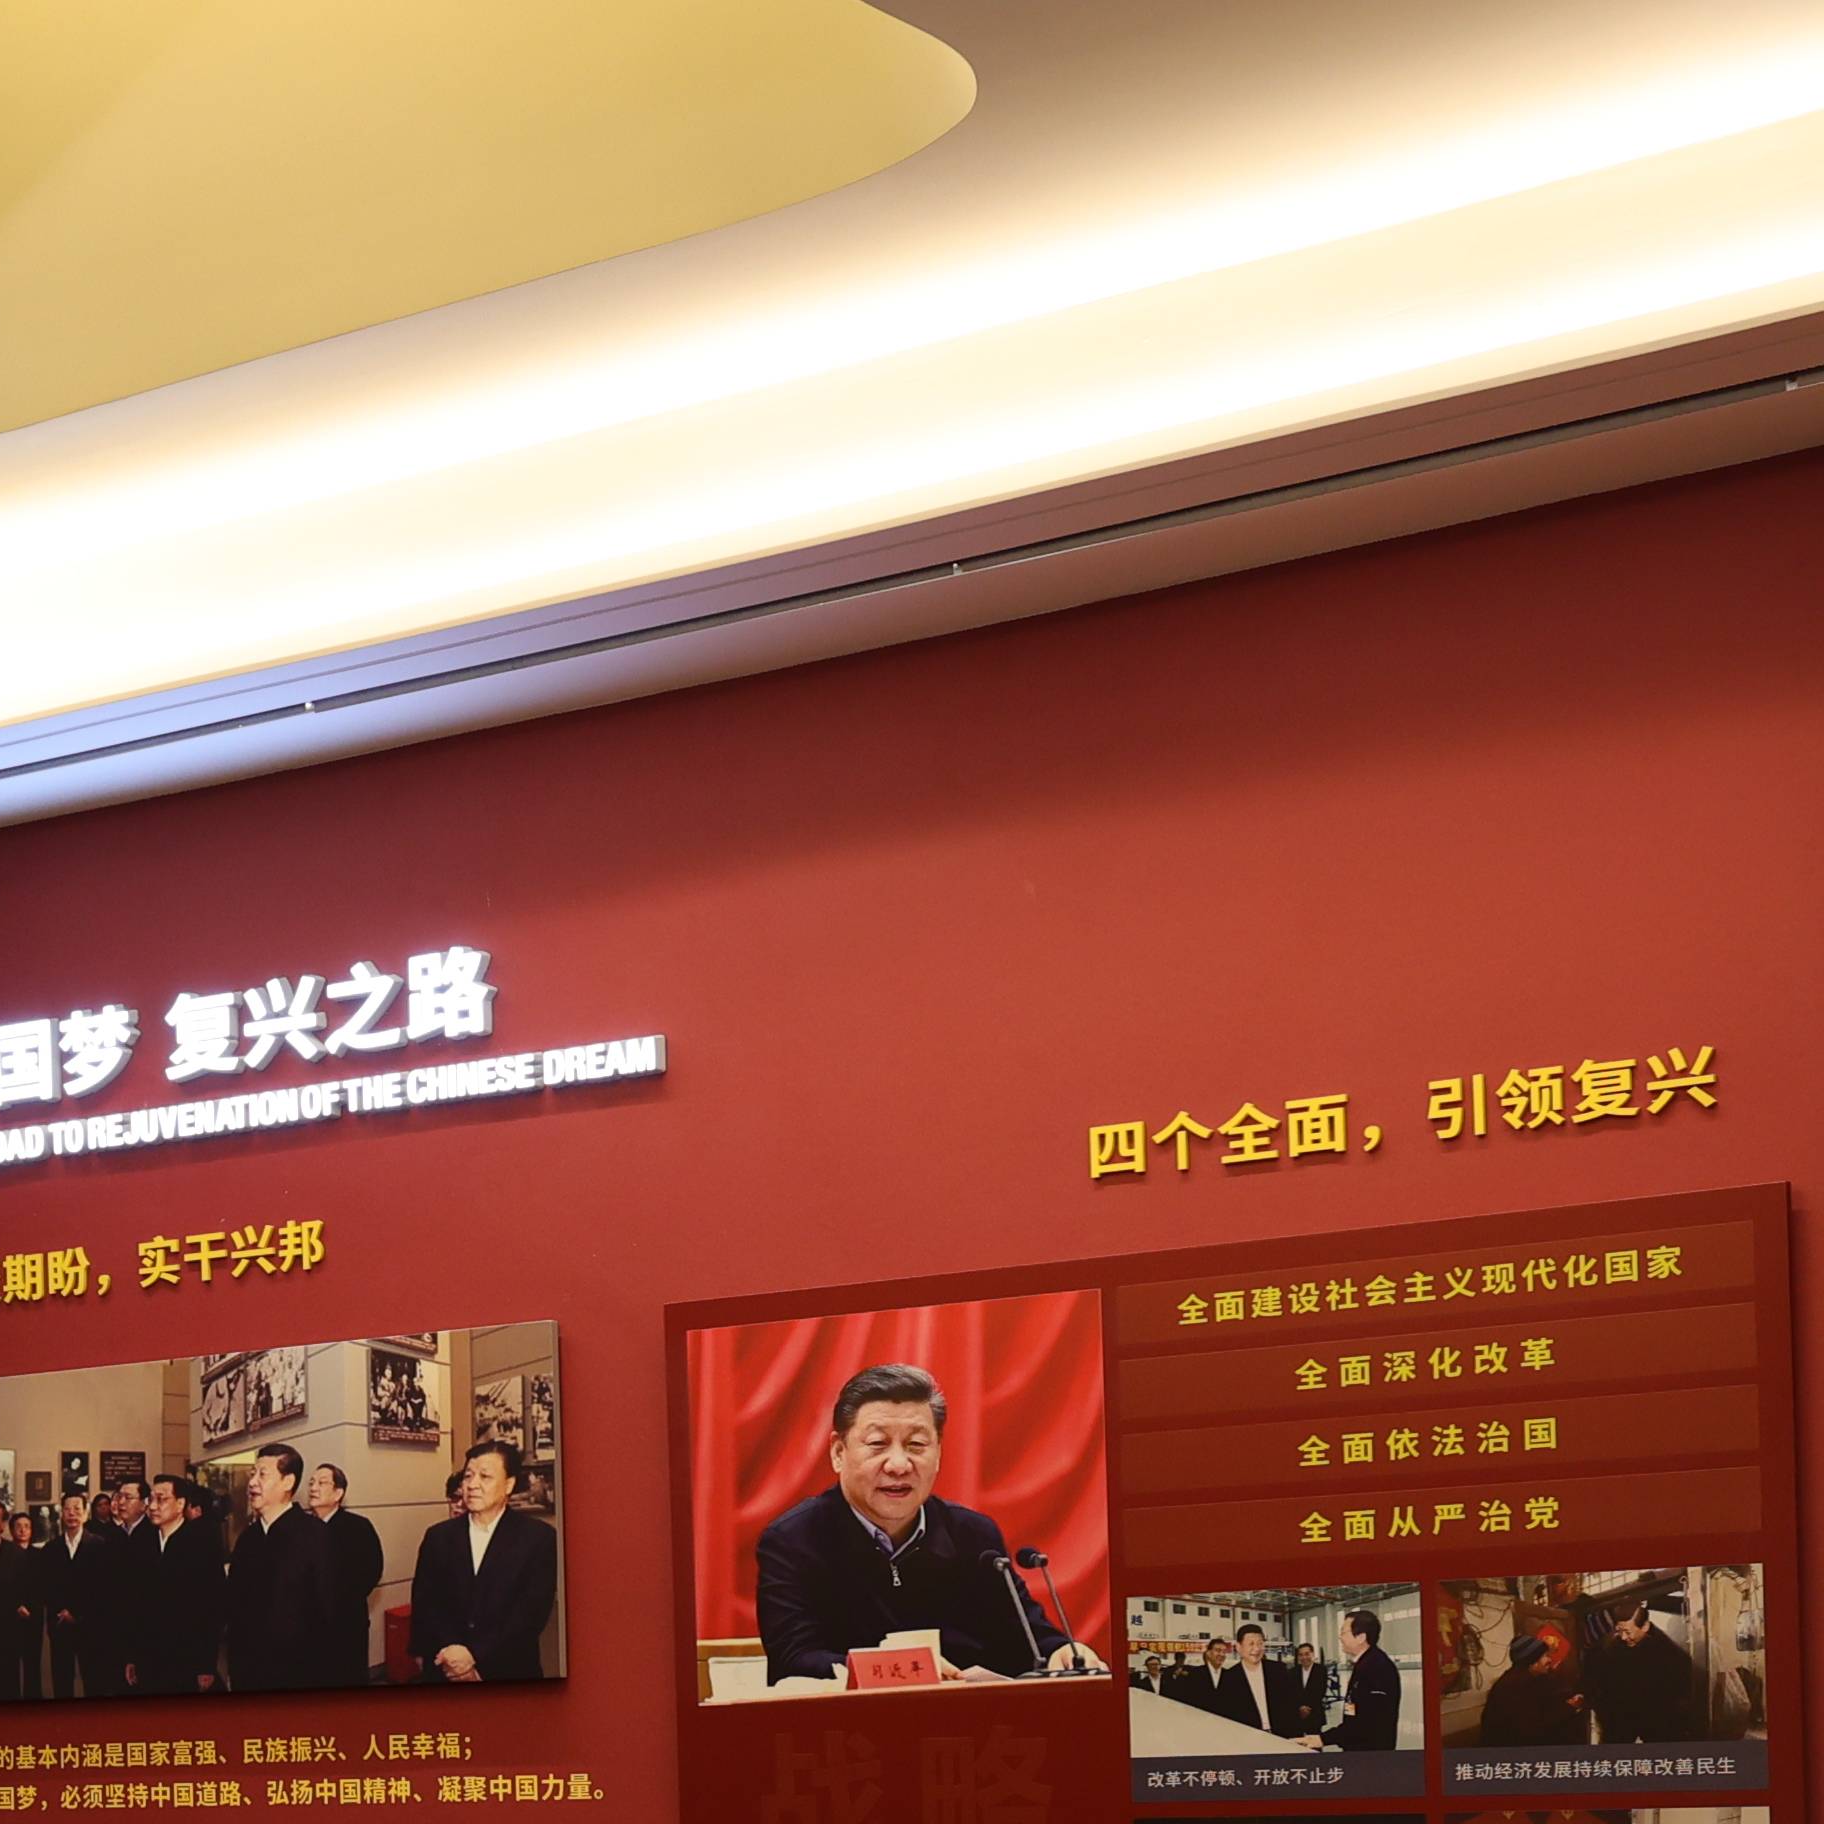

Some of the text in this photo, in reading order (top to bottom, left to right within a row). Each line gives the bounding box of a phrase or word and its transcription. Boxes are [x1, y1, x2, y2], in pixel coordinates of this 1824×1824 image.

[164, 946, 495, 1082] 复兴之路
[47, 1121, 86, 1157] TO
[88, 1087, 298, 1152] REJUVENATION
[300, 1082, 344, 1124] OF
[345, 1072, 405, 1114] THE
[406, 1053, 537, 1107] CHINESE
[542, 1034, 664, 1086] DREAM
[1088, 1045, 1719, 1181] 四个全面，引领复兴
[1177, 1245, 1684, 1327] 全面建设社会主义现代化国家
[1294, 1337, 1556, 1393] 全面深化改革
[1297, 1416, 1559, 1470] 全面依法治国
[1298, 1496, 1561, 1546] 全面从严治党
[1147, 1766, 1345, 1788] 改革不停顿、开放不止步
[1455, 1756, 1736, 1781] 推动经济发展持续保障改善民生
